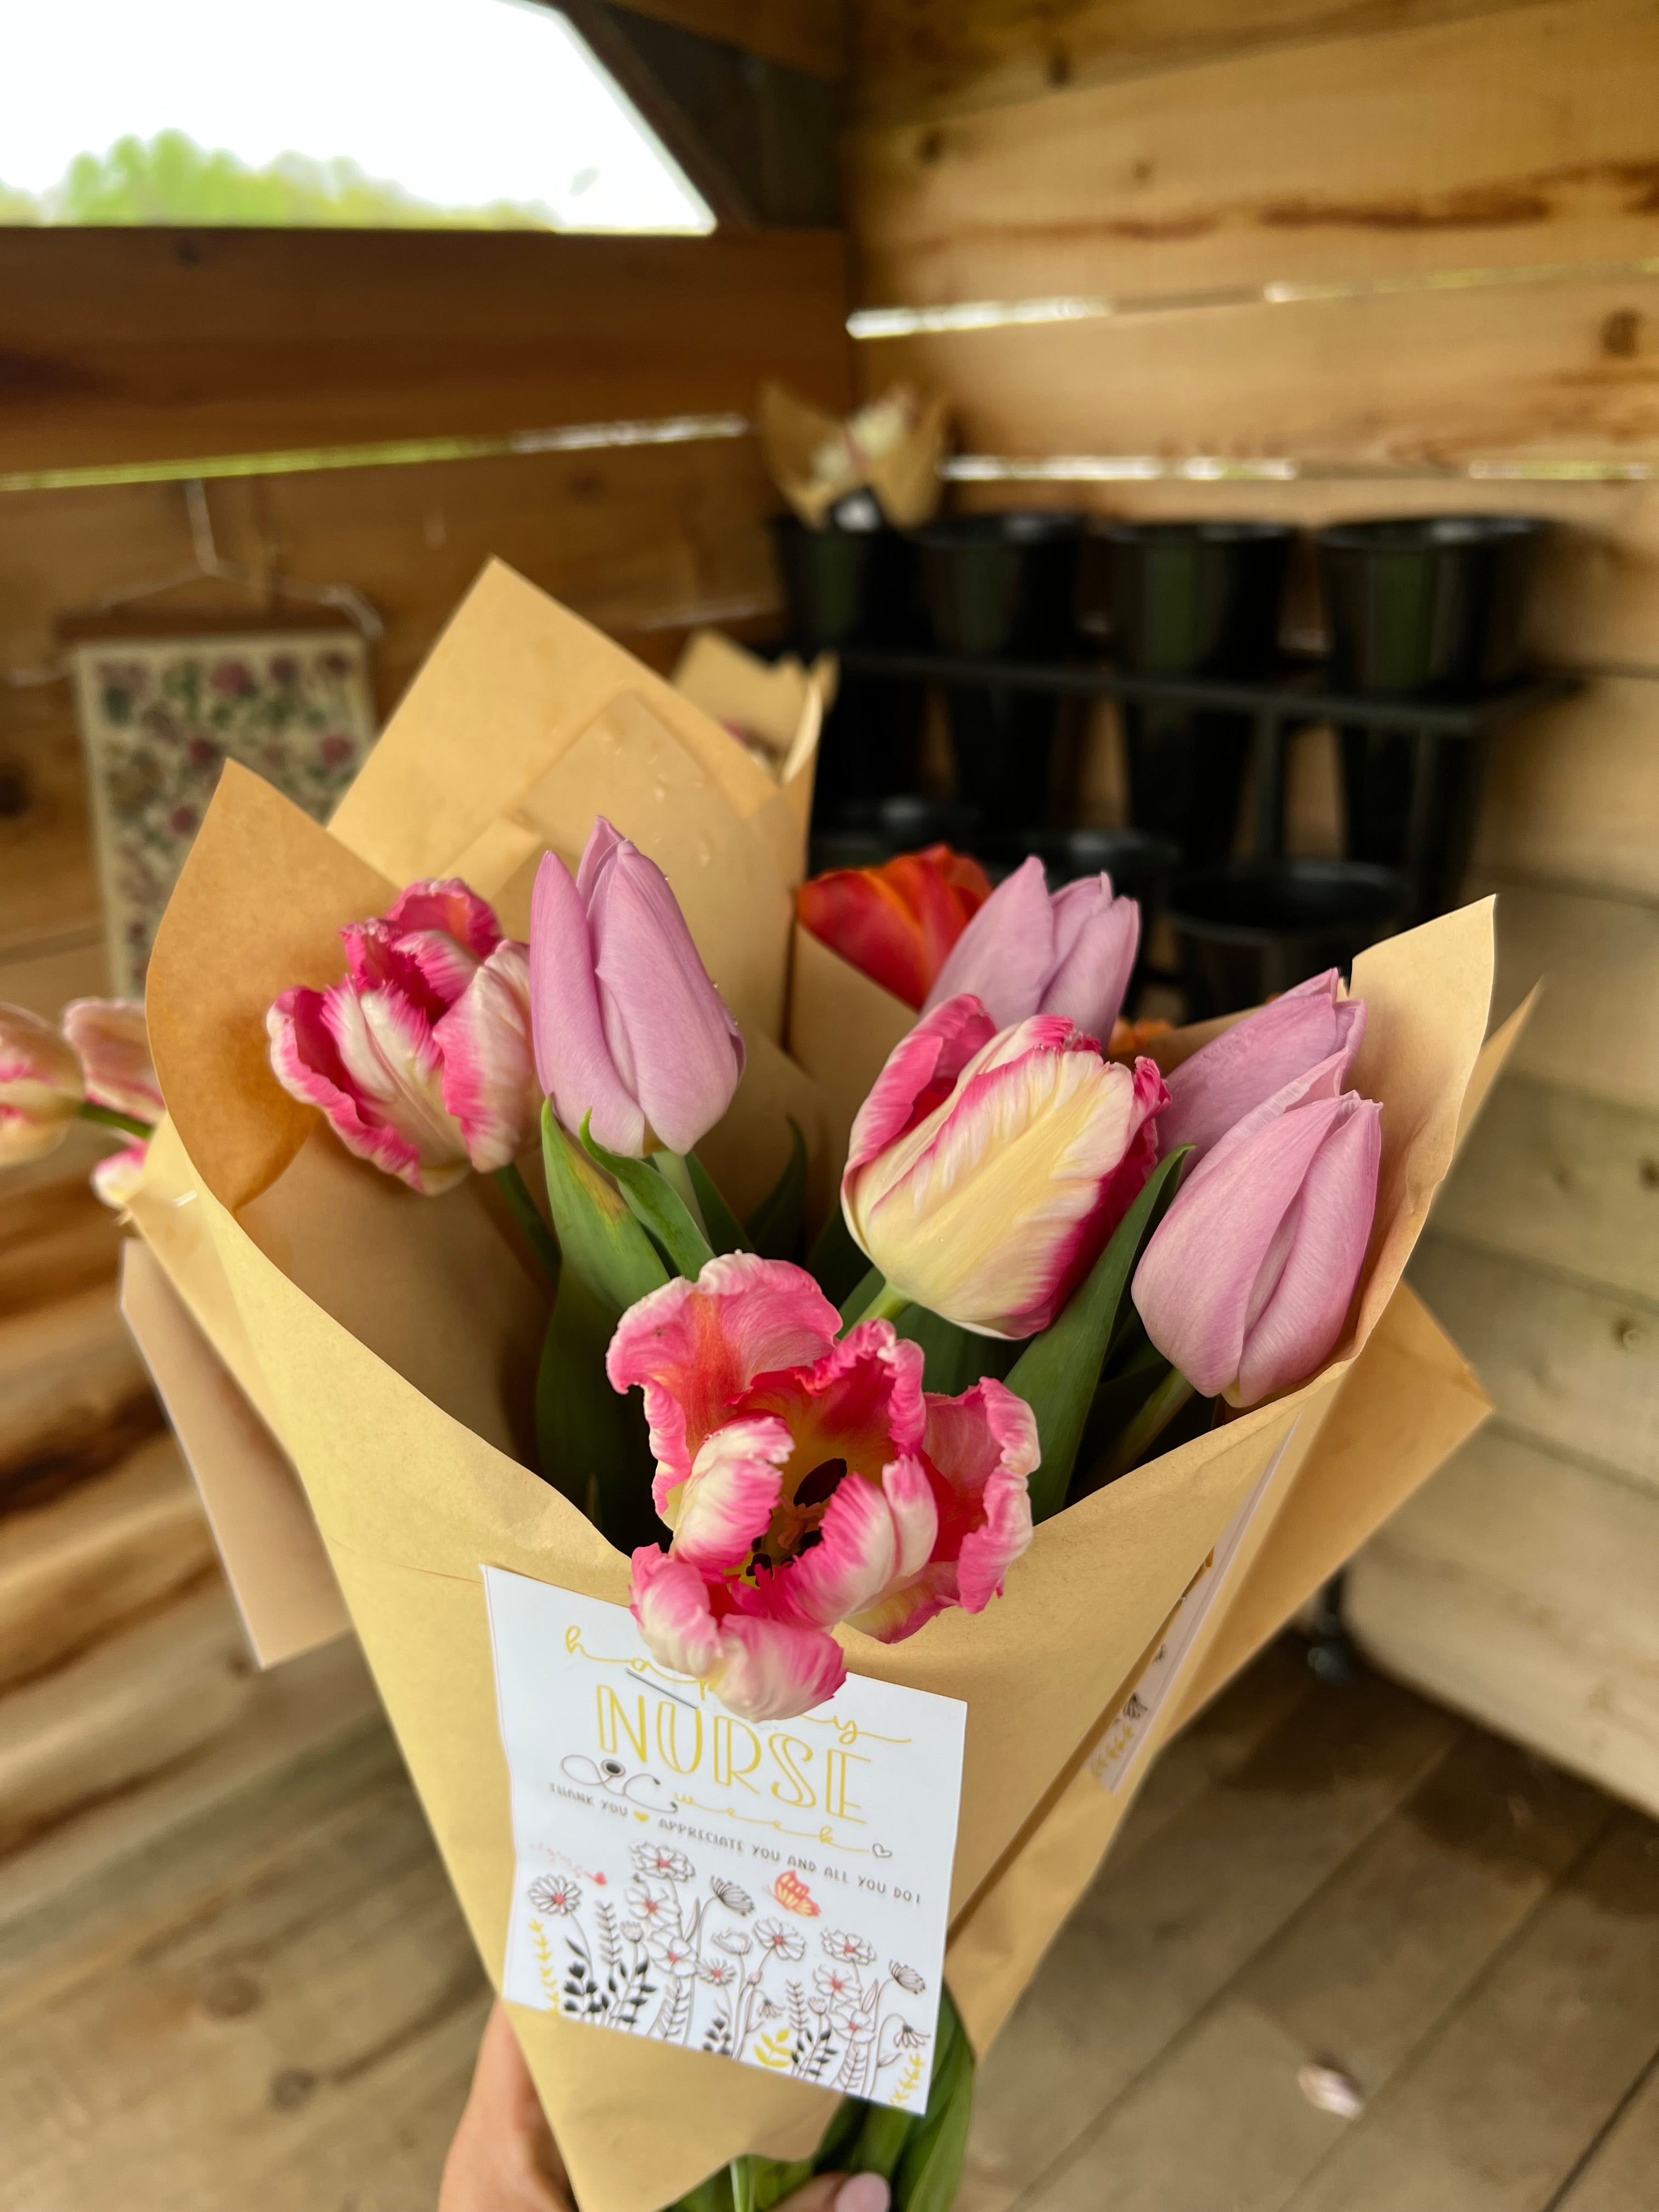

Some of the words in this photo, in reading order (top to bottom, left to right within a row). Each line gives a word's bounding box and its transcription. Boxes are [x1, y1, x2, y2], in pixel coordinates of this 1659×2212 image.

[596, 1684, 871, 1824] NURSE
[549, 1783, 592, 1804] THANK
[601, 1799, 628, 1817] YOU
[658, 1818, 744, 1852] APPRECIATE
[752, 1844, 780, 1862] YOU
[787, 1855, 816, 1872] AND
[824, 1867, 848, 1883] ALL
[858, 1876, 887, 1894] YOU
[673, 1791, 870, 1853] week
